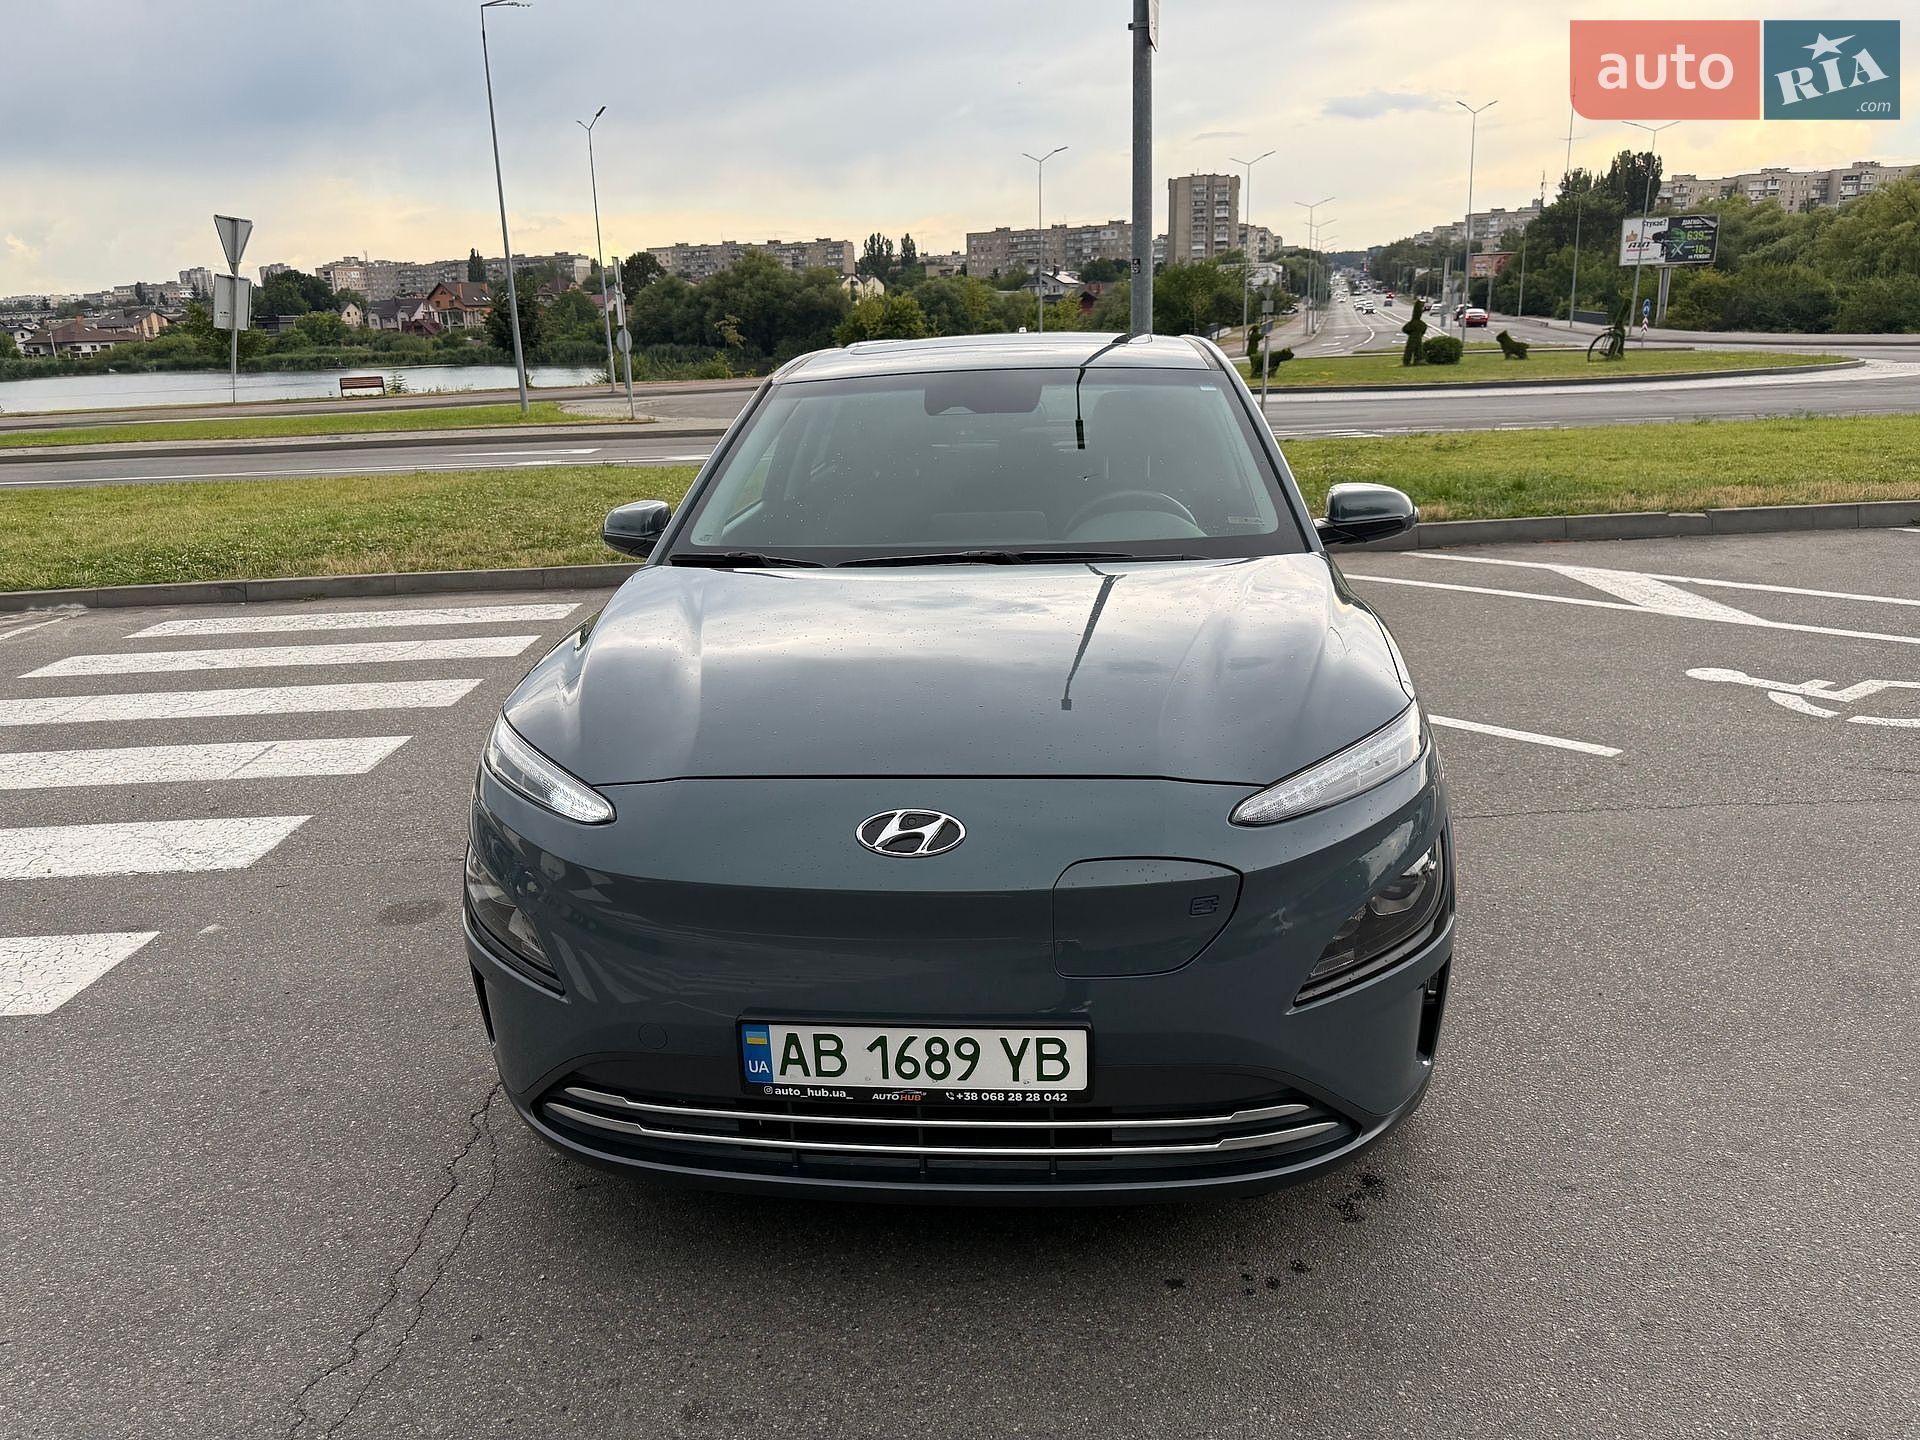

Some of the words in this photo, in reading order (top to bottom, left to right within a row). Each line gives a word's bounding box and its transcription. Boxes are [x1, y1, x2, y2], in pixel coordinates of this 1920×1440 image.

[1687, 230, 1704, 241] 639
[780, 1032, 848, 1078] AB
[866, 1035, 981, 1081] 1689
[999, 1037, 1071, 1082] YB
[749, 1060, 770, 1073] UA
[956, 1092, 978, 1101] +38
[981, 1092, 1005, 1101] 068
[1008, 1092, 1023, 1101] 28
[1025, 1092, 1041, 1101] 28
[1044, 1092, 1068, 1102] 042
